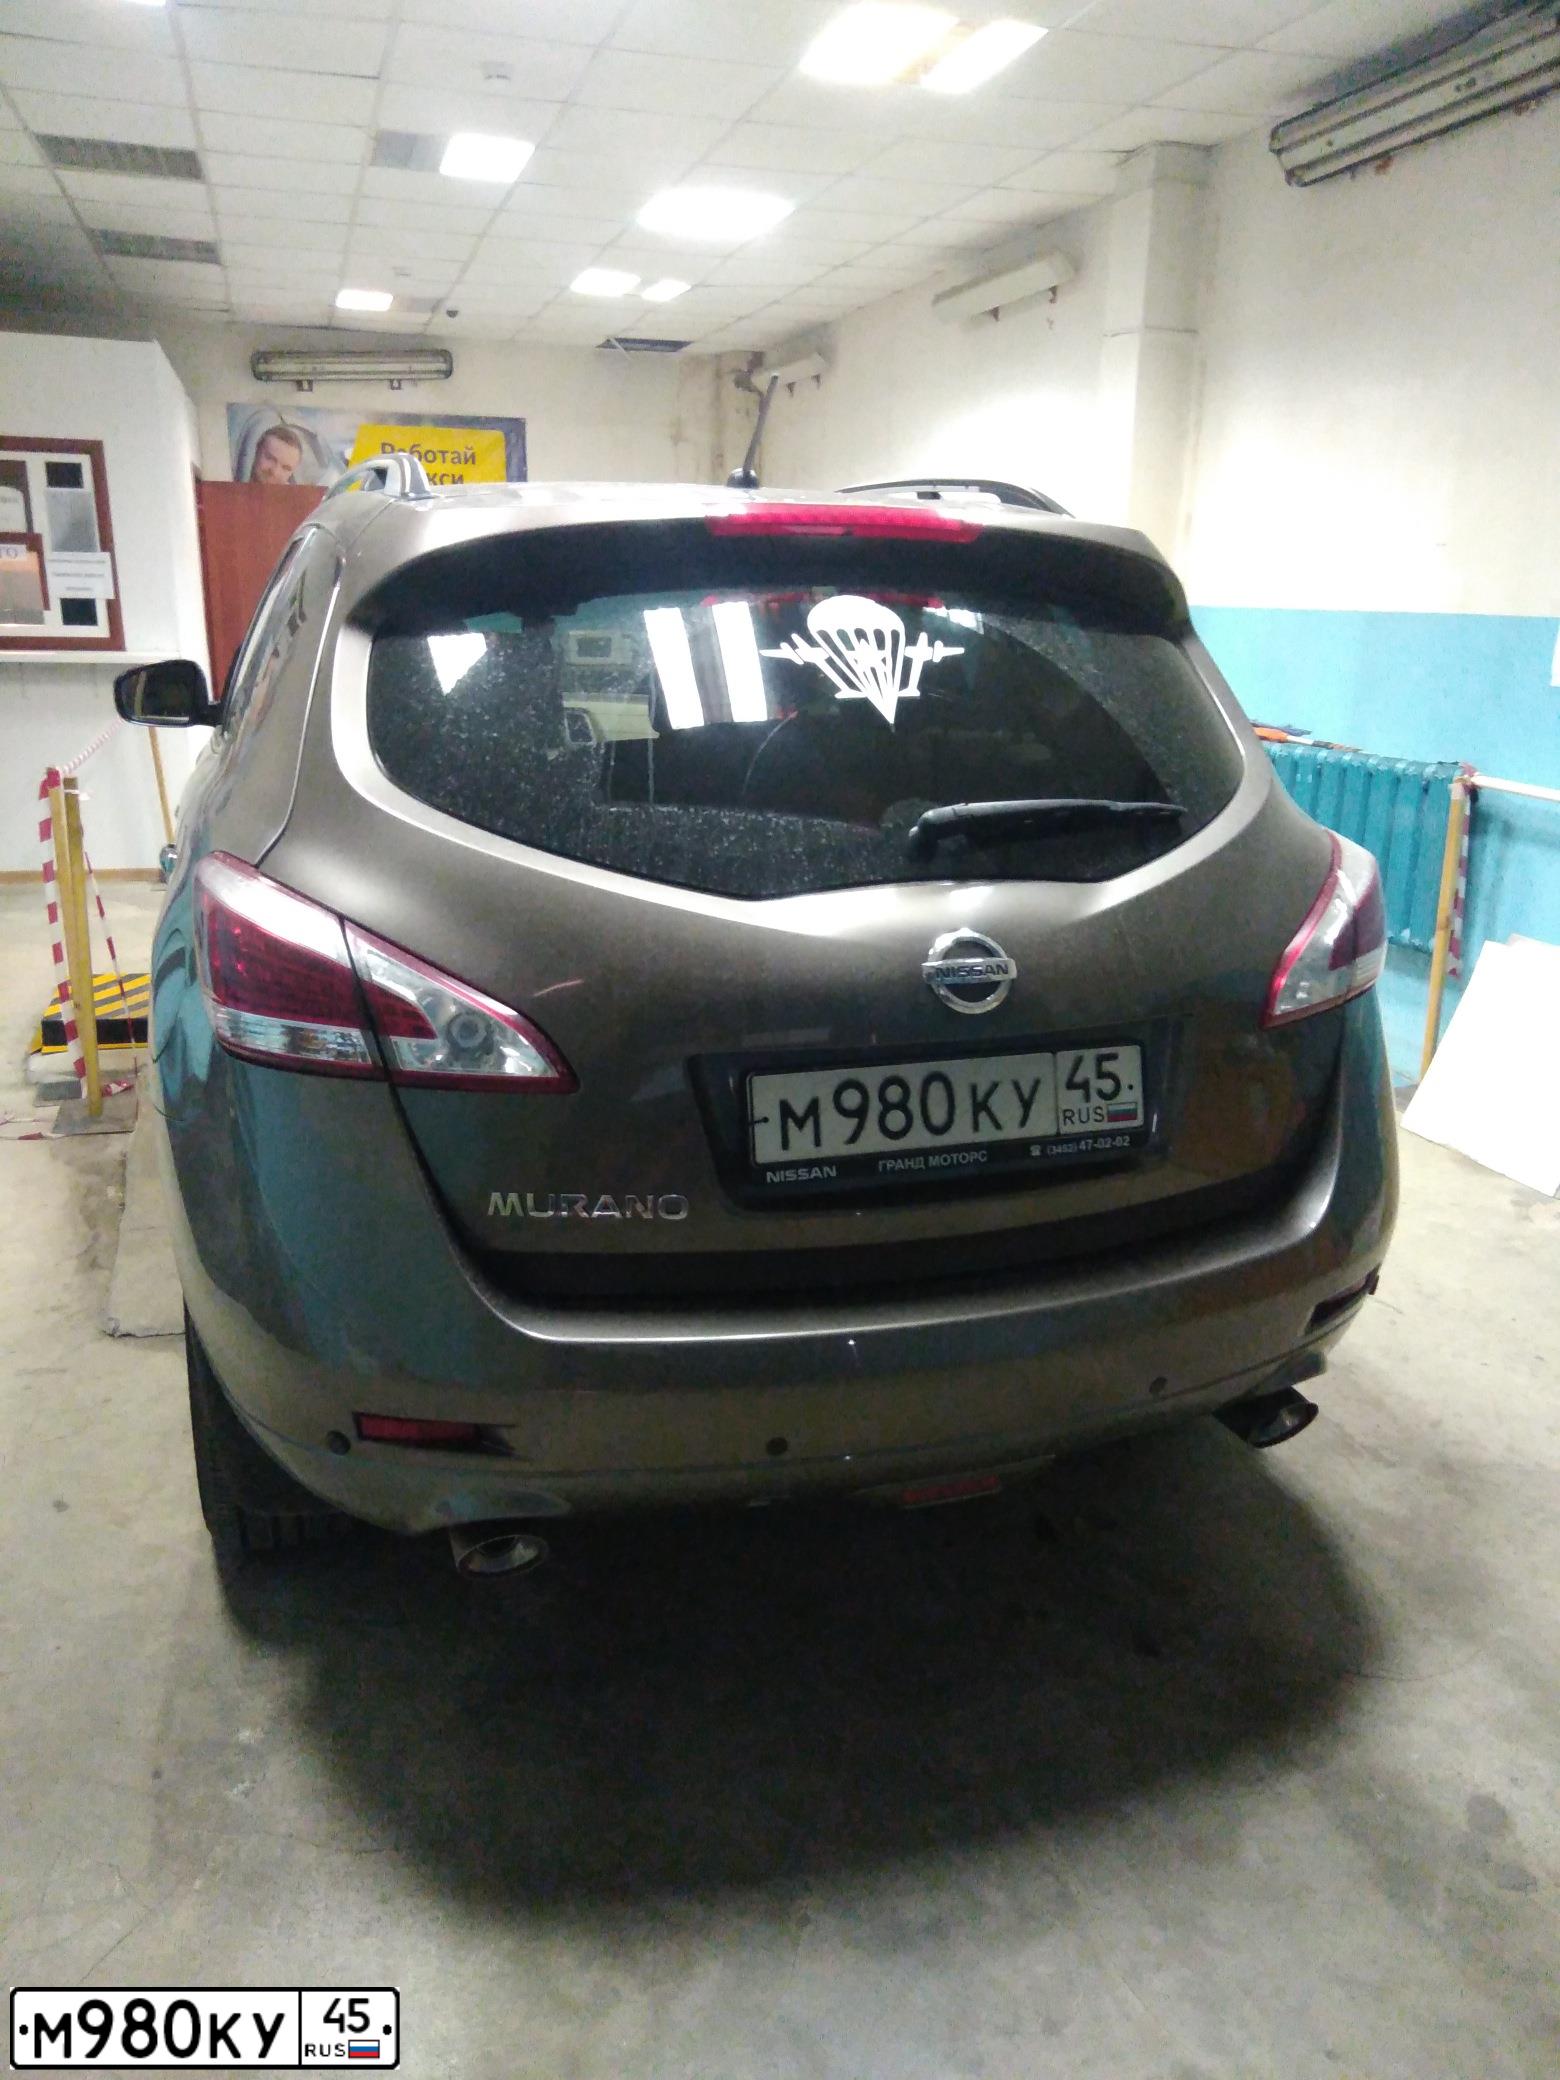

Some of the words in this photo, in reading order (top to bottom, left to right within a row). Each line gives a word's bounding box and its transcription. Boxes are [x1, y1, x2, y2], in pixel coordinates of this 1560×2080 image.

[380, 442, 476, 465] Рботай
[935, 964, 1009, 978] NISSAN
[1065, 1052, 1121, 1104] 45
[1062, 1106, 1105, 1126] RUS
[878, 1158, 926, 1173] ГРАНД
[928, 1150, 988, 1168] МОТОРС
[766, 1165, 837, 1183] NISSAN
[487, 1191, 690, 1220] MURANO
